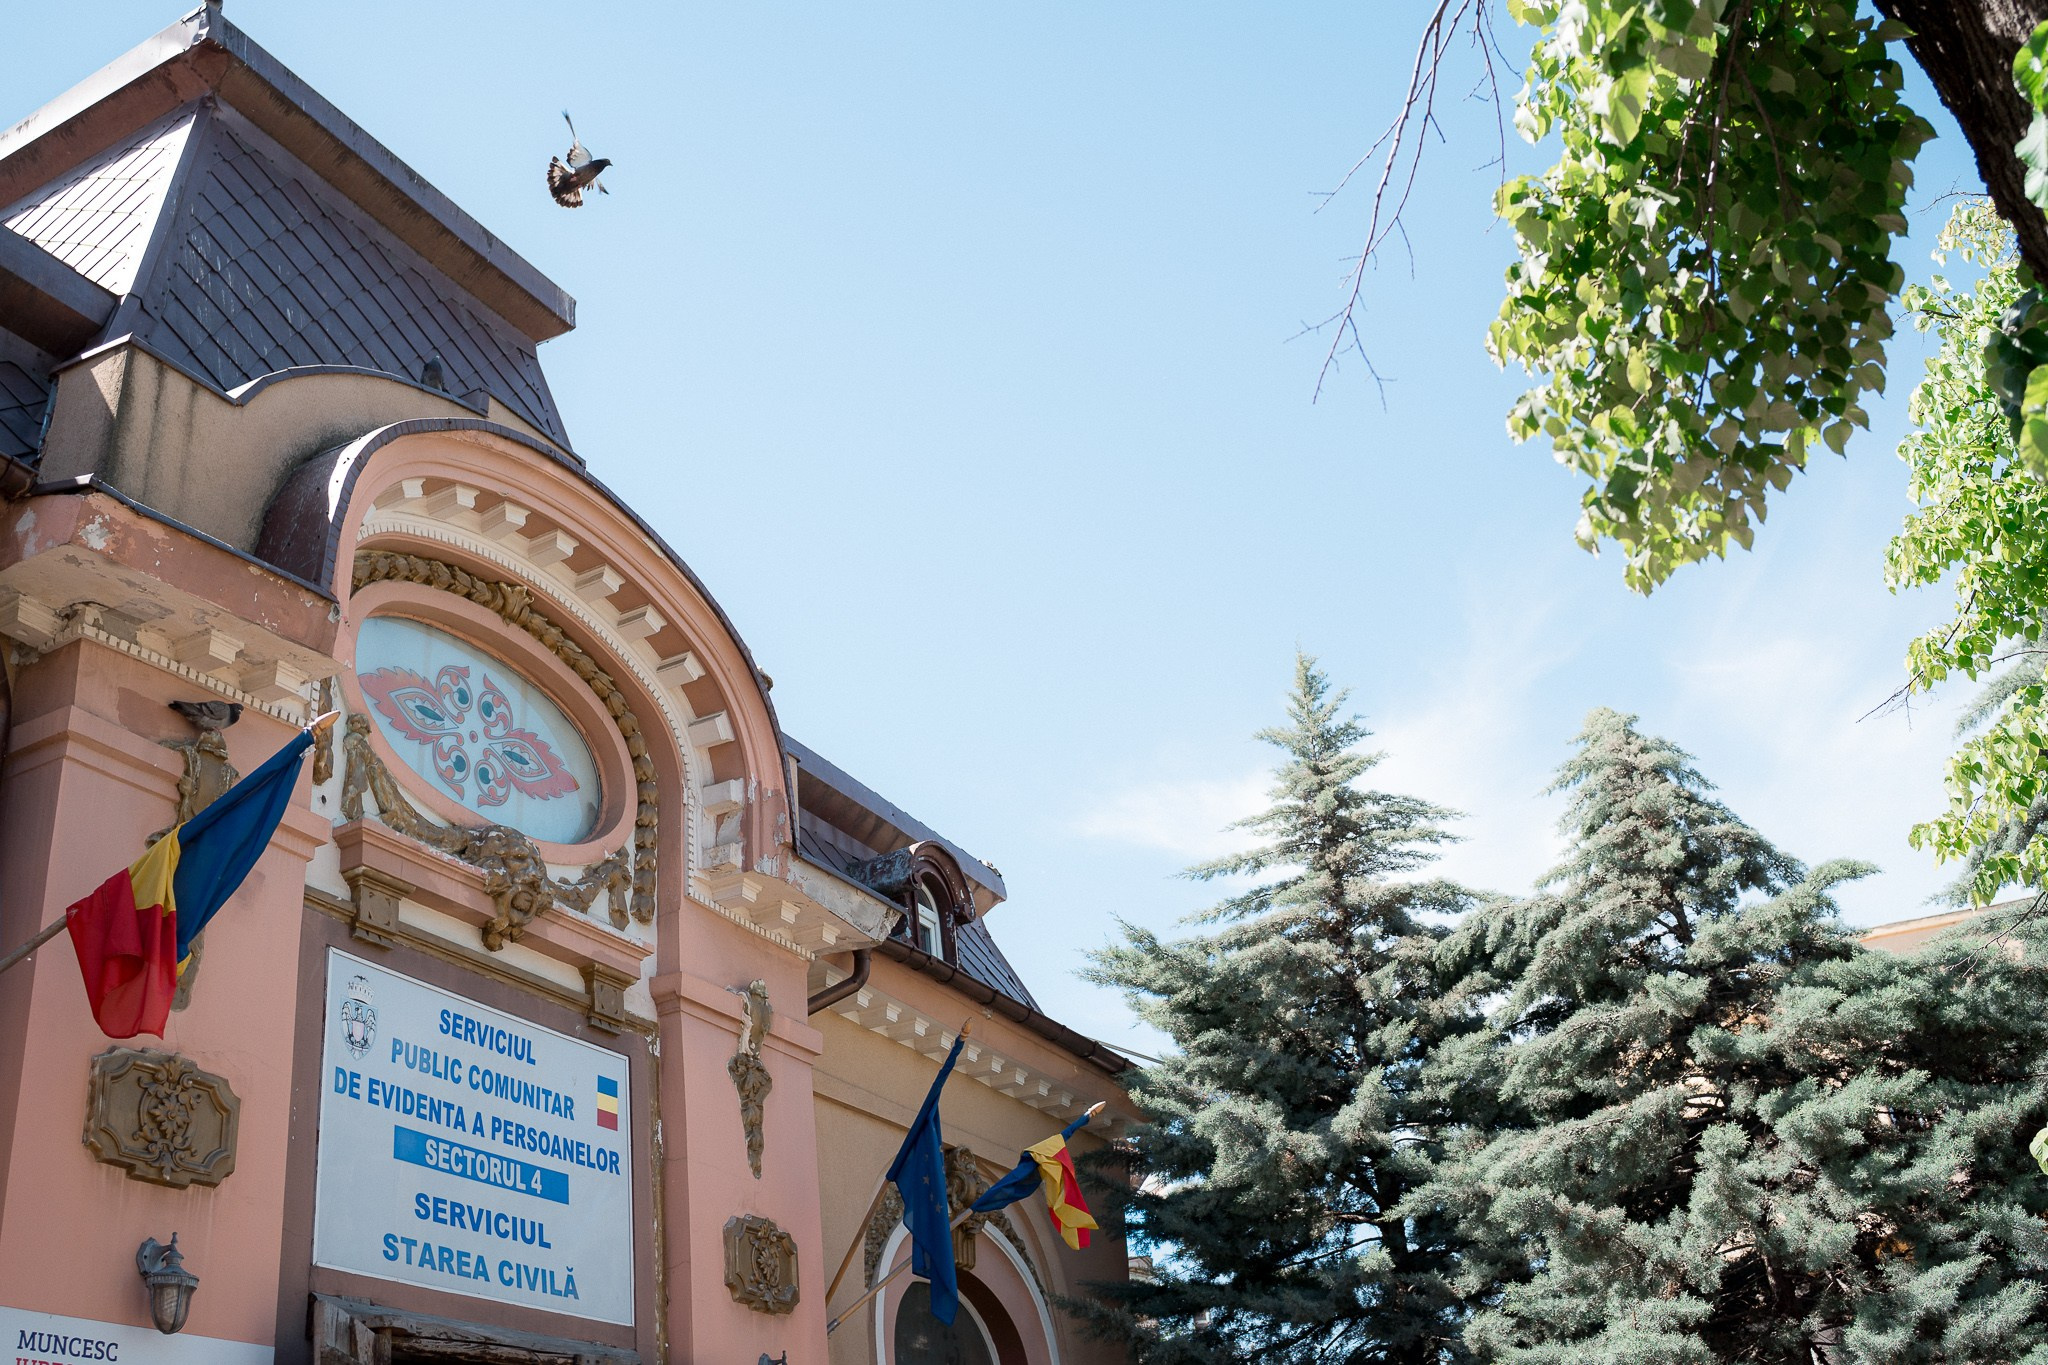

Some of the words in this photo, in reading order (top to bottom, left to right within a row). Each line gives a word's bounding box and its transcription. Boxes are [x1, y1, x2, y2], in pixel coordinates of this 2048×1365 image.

[439, 1009, 536, 1065] SERVICIUL
[391, 1037, 462, 1084] PUBLIC
[468, 1065, 575, 1121] COMUNITAR
[334, 1066, 361, 1100] DE
[367, 1077, 467, 1132] EVIDENTA
[471, 1112, 486, 1138] A
[491, 1116, 621, 1176] PERSOANELOR
[425, 1139, 527, 1191] SECTORUL
[530, 1170, 542, 1194] 4
[414, 1193, 551, 1249] SERVICIUL
[382, 1233, 491, 1282] STAREA
[497, 1260, 580, 1300] CIVILĂ
[17, 1329, 119, 1362] MUNCESC
